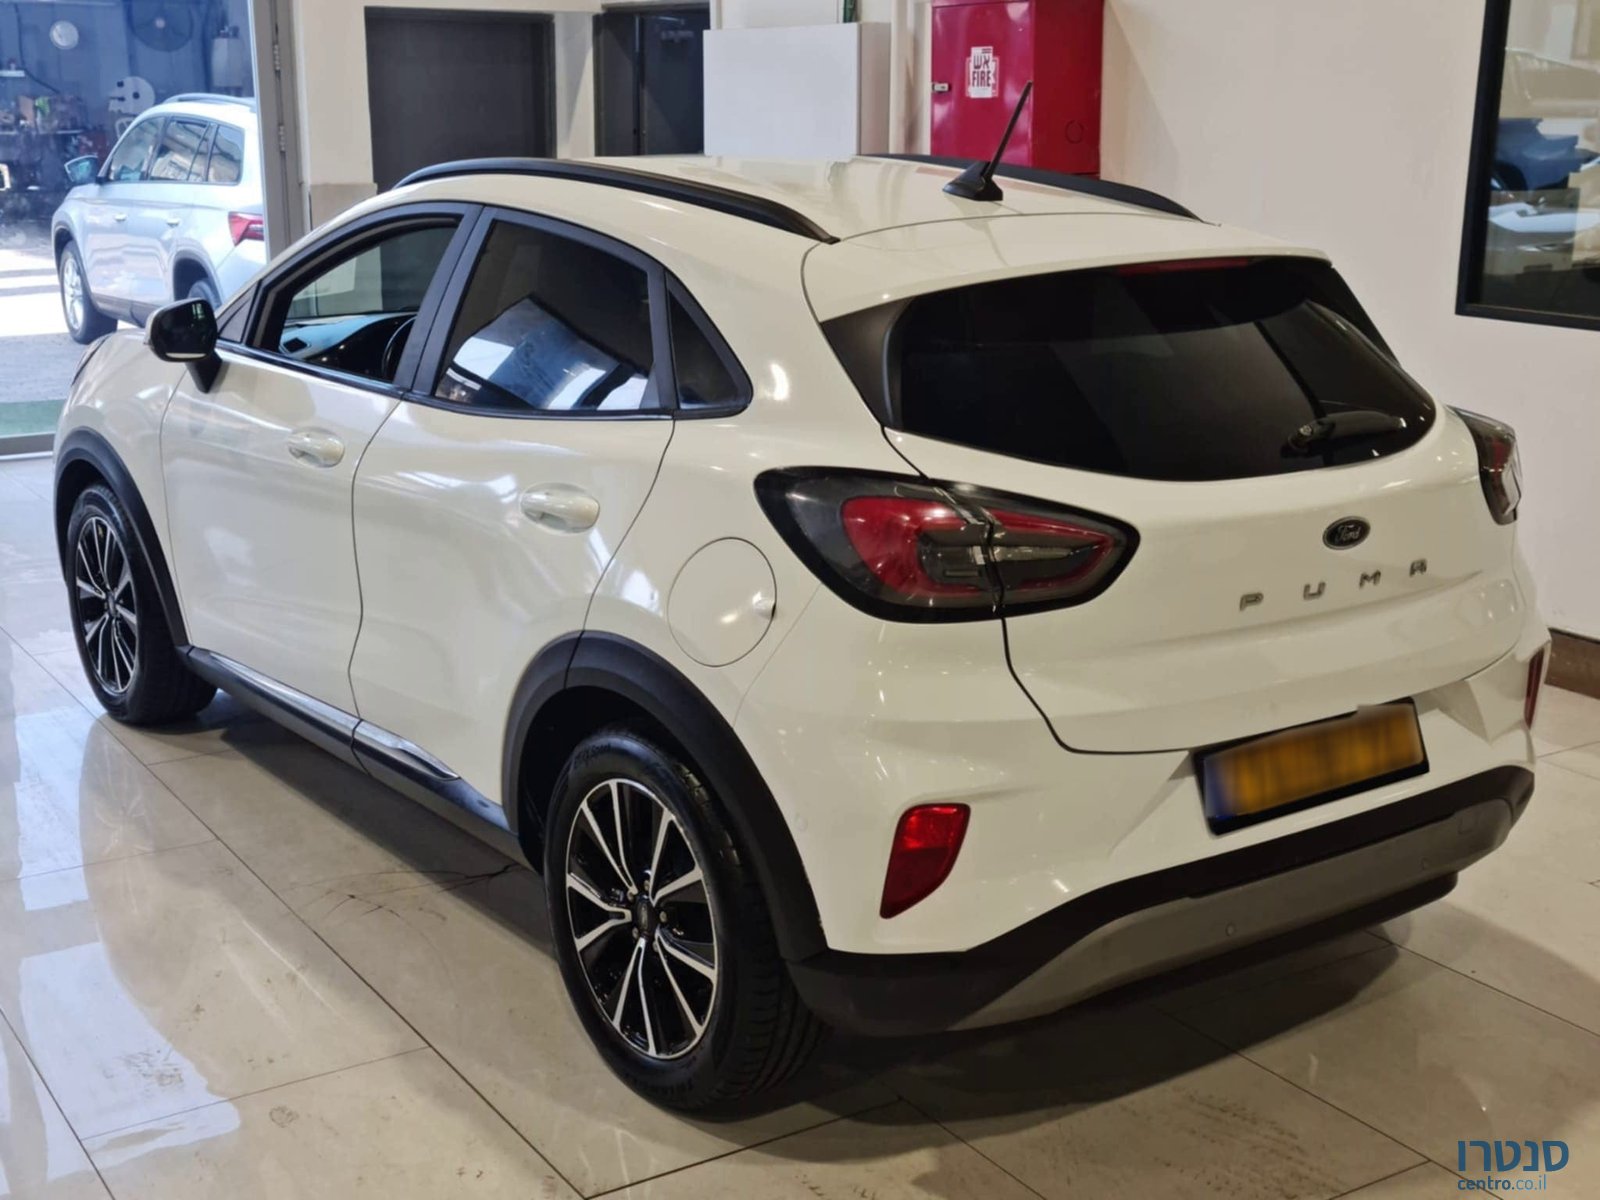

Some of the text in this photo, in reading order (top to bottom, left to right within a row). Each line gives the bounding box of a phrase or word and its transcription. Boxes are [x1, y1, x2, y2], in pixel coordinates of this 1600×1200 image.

[973, 55, 991, 69] אש
[972, 70, 991, 87] FIRE
[1334, 524, 1362, 544] Ford
[1239, 558, 1428, 611] PUMA
